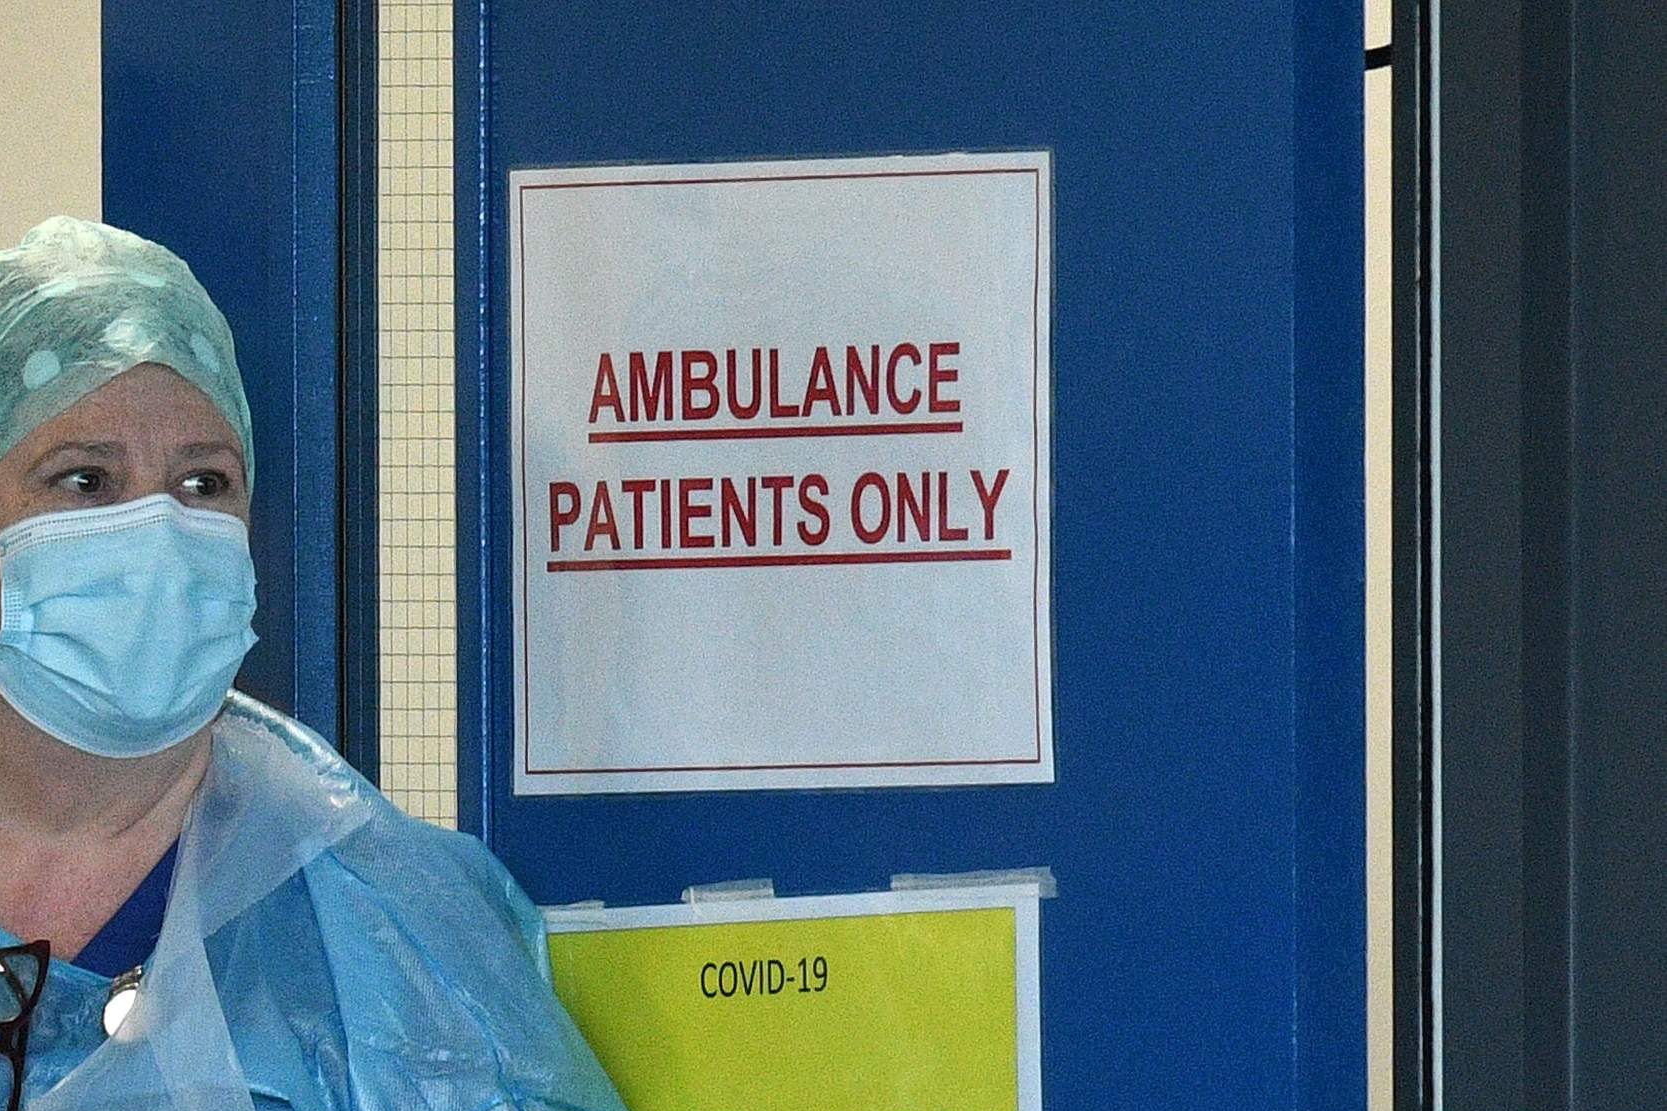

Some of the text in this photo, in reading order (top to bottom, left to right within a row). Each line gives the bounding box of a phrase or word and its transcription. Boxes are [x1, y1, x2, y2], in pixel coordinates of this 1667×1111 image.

[588, 342, 961, 423] AMBULANCE
[548, 469, 1011, 553] PATIENTS ONLY
[699, 956, 829, 998] COVID-19
